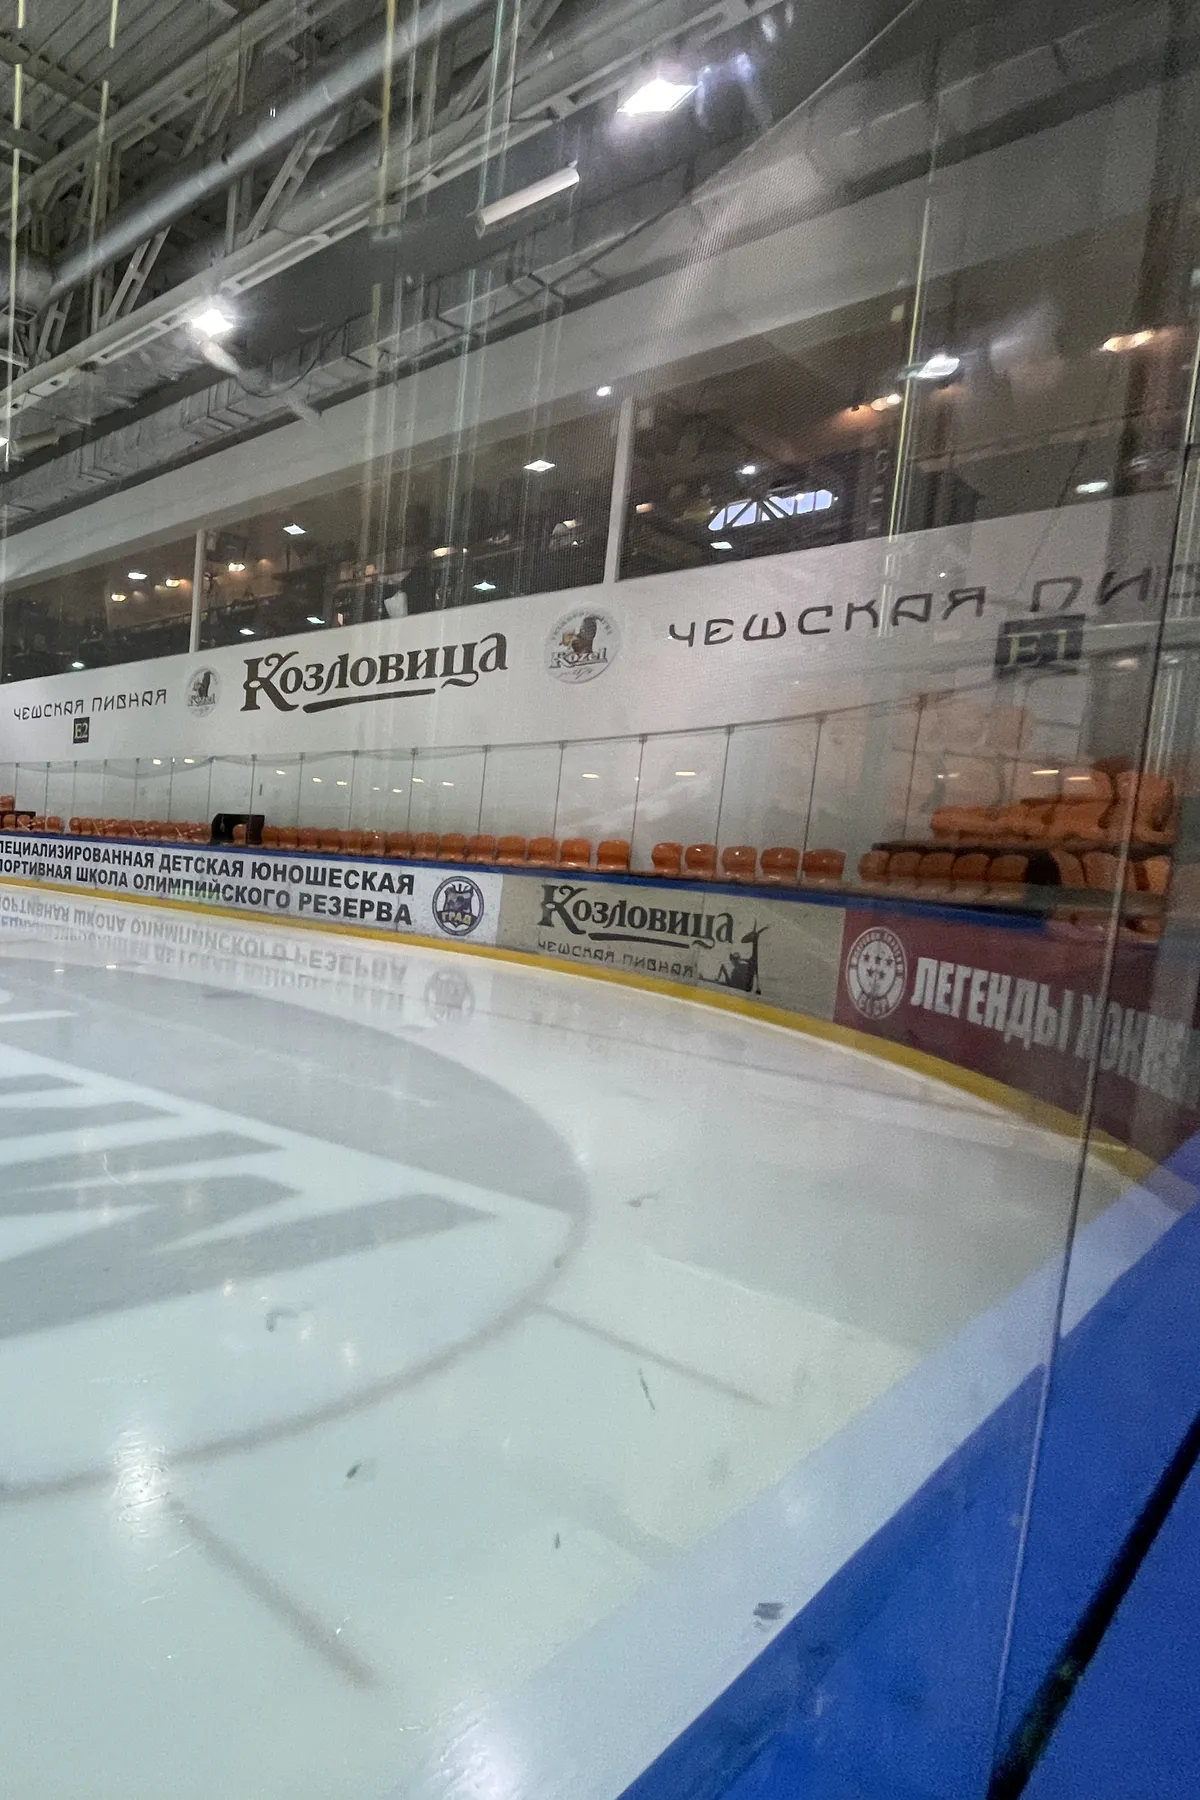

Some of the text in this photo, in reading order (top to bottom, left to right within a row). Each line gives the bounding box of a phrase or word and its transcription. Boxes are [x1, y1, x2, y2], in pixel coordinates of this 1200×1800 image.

[668, 585, 987, 647] ЧЕШСКАЯ
[240, 632, 509, 713] Козловица
[13, 689, 167, 720] ЧЕШСКАЯ ПИВНАЯ
[74, 722, 89, 739] E2
[76, 868, 128, 888] ШКОЛА
[133, 873, 291, 909] ОЛИМПИЙСКОГО
[298, 891, 413, 926] РЕЗЕРВА
[158, 854, 244, 878] ДЕТСКАЯ
[251, 861, 415, 896] ЮНОШЕСКАЯ
[441, 911, 472, 927] ГРАД
[537, 884, 734, 949] Козловица
[538, 938, 694, 978] ЧЕШСКАЯ ПИВНАЯ
[910, 956, 1074, 1052] ЛЕГЕНДЫ
